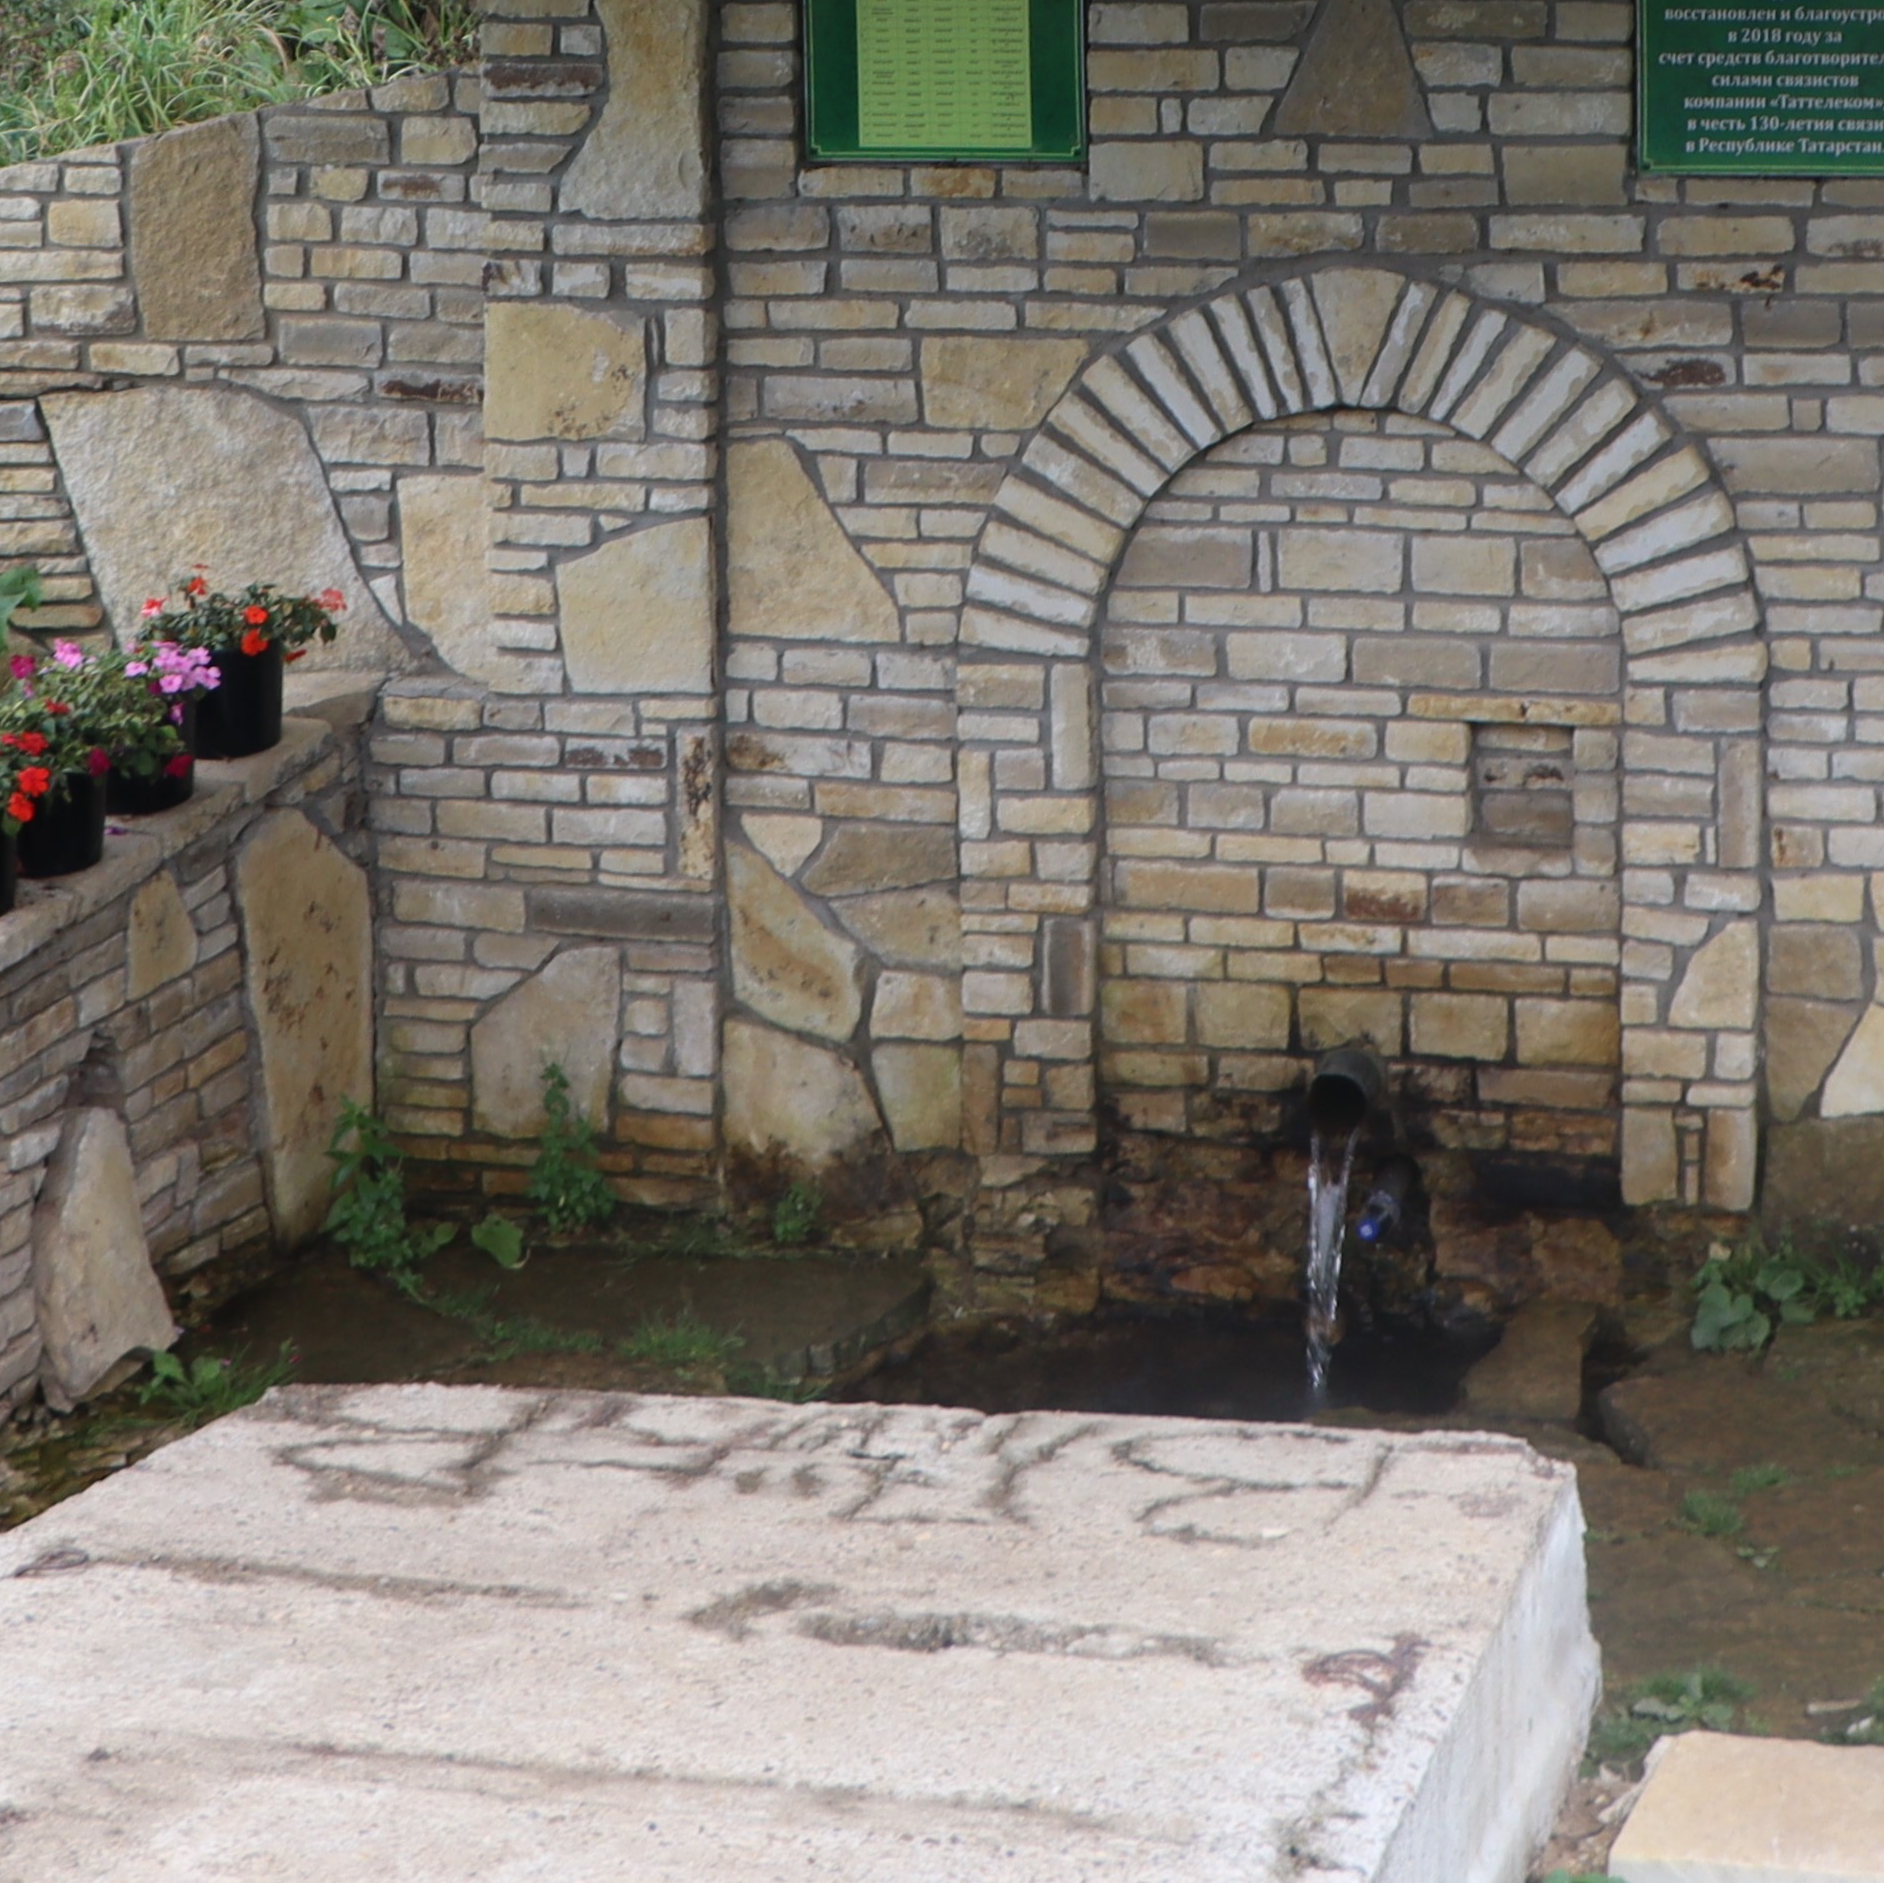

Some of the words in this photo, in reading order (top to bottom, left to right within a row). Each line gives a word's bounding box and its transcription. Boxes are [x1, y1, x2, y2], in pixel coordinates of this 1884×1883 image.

[1664, 9, 1776, 21] восстановлен
[1780, 10, 1791, 21] и
[1728, 31, 1737, 42] в
[1742, 28, 1782, 42] 2018
[1785, 31, 1822, 45] году
[1825, 31, 1842, 42] за
[1658, 53, 1695, 64] счет
[1697, 52, 1762, 69] средств
[1711, 75, 1773, 87] силами
[1776, 75, 1859, 87] связистов
[1683, 97, 1766, 109] компании
[1687, 119, 1697, 130] в
[1700, 119, 1746, 131] честь
[1750, 116, 1834, 131] 130-летия
[1837, 119, 1884, 131] связи
[1685, 140, 1696, 153] в
[1699, 137, 1795, 155] Республике
